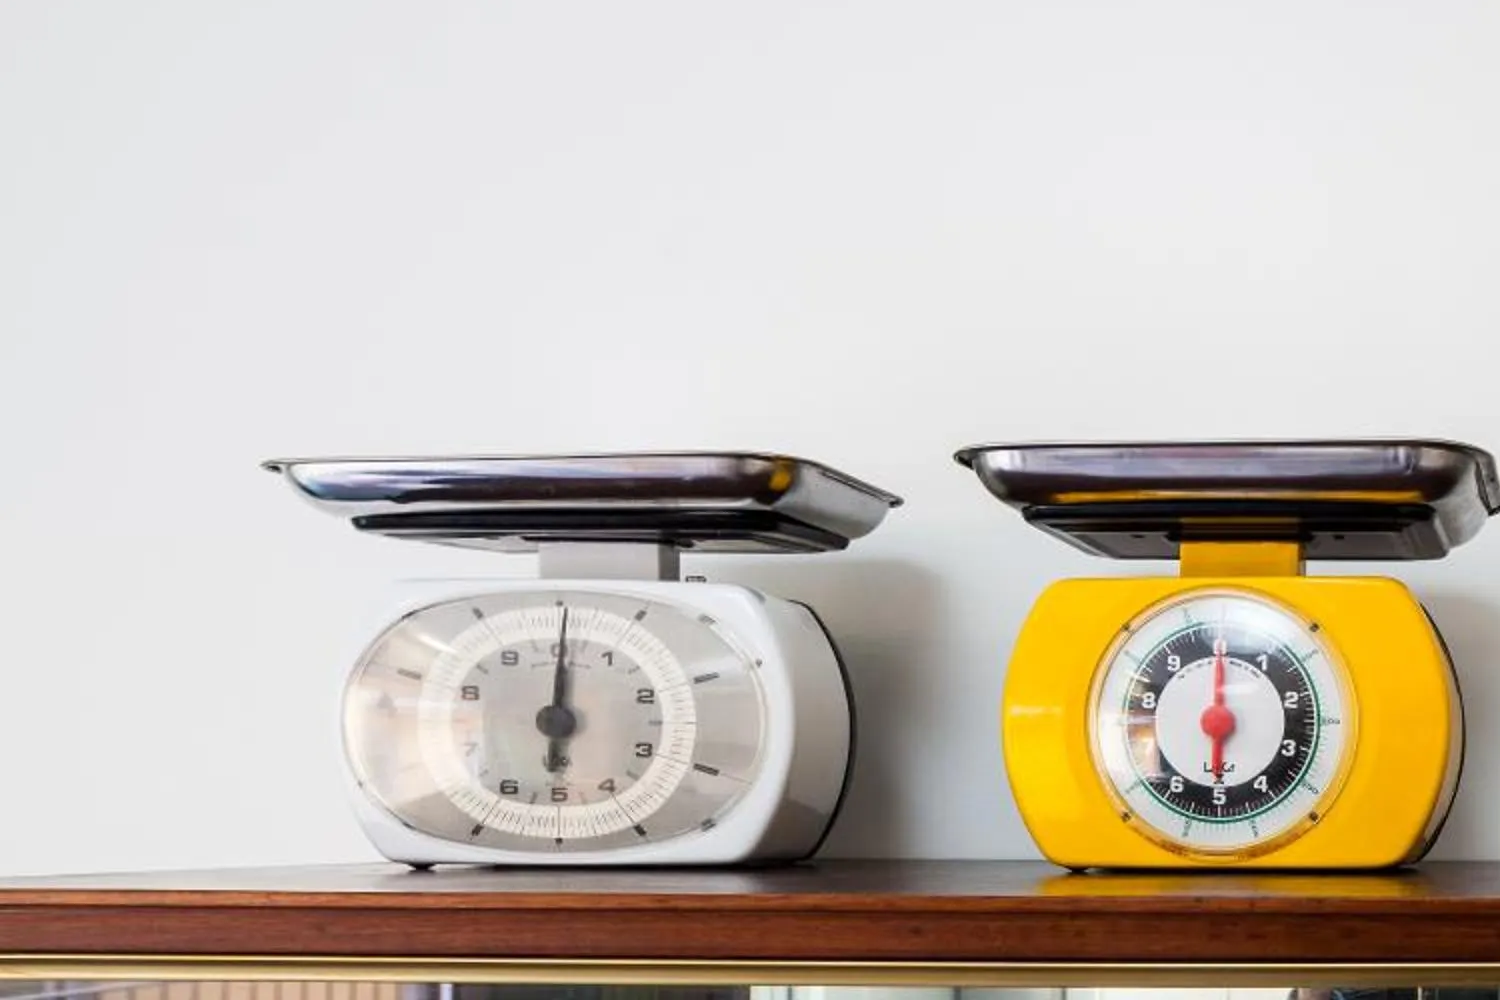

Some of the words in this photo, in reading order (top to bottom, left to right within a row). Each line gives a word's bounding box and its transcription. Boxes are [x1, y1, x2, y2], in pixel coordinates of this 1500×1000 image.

[500, 650, 519, 666] 9
[601, 651, 613, 667] 1
[1167, 655, 1181, 672] 9
[1256, 653, 1268, 671] 1
[461, 685, 479, 701] 8
[636, 688, 655, 704] 2
[1142, 692, 1156, 708] 8
[1285, 691, 1298, 708] 2
[635, 743, 653, 758] 3
[1281, 740, 1296, 757] 3
[500, 779, 518, 795] 6
[598, 778, 616, 793] 4
[1170, 776, 1184, 792] 6
[1253, 775, 1268, 792] 4
[551, 787, 568, 802] 5
[1212, 788, 1226, 805] 5
